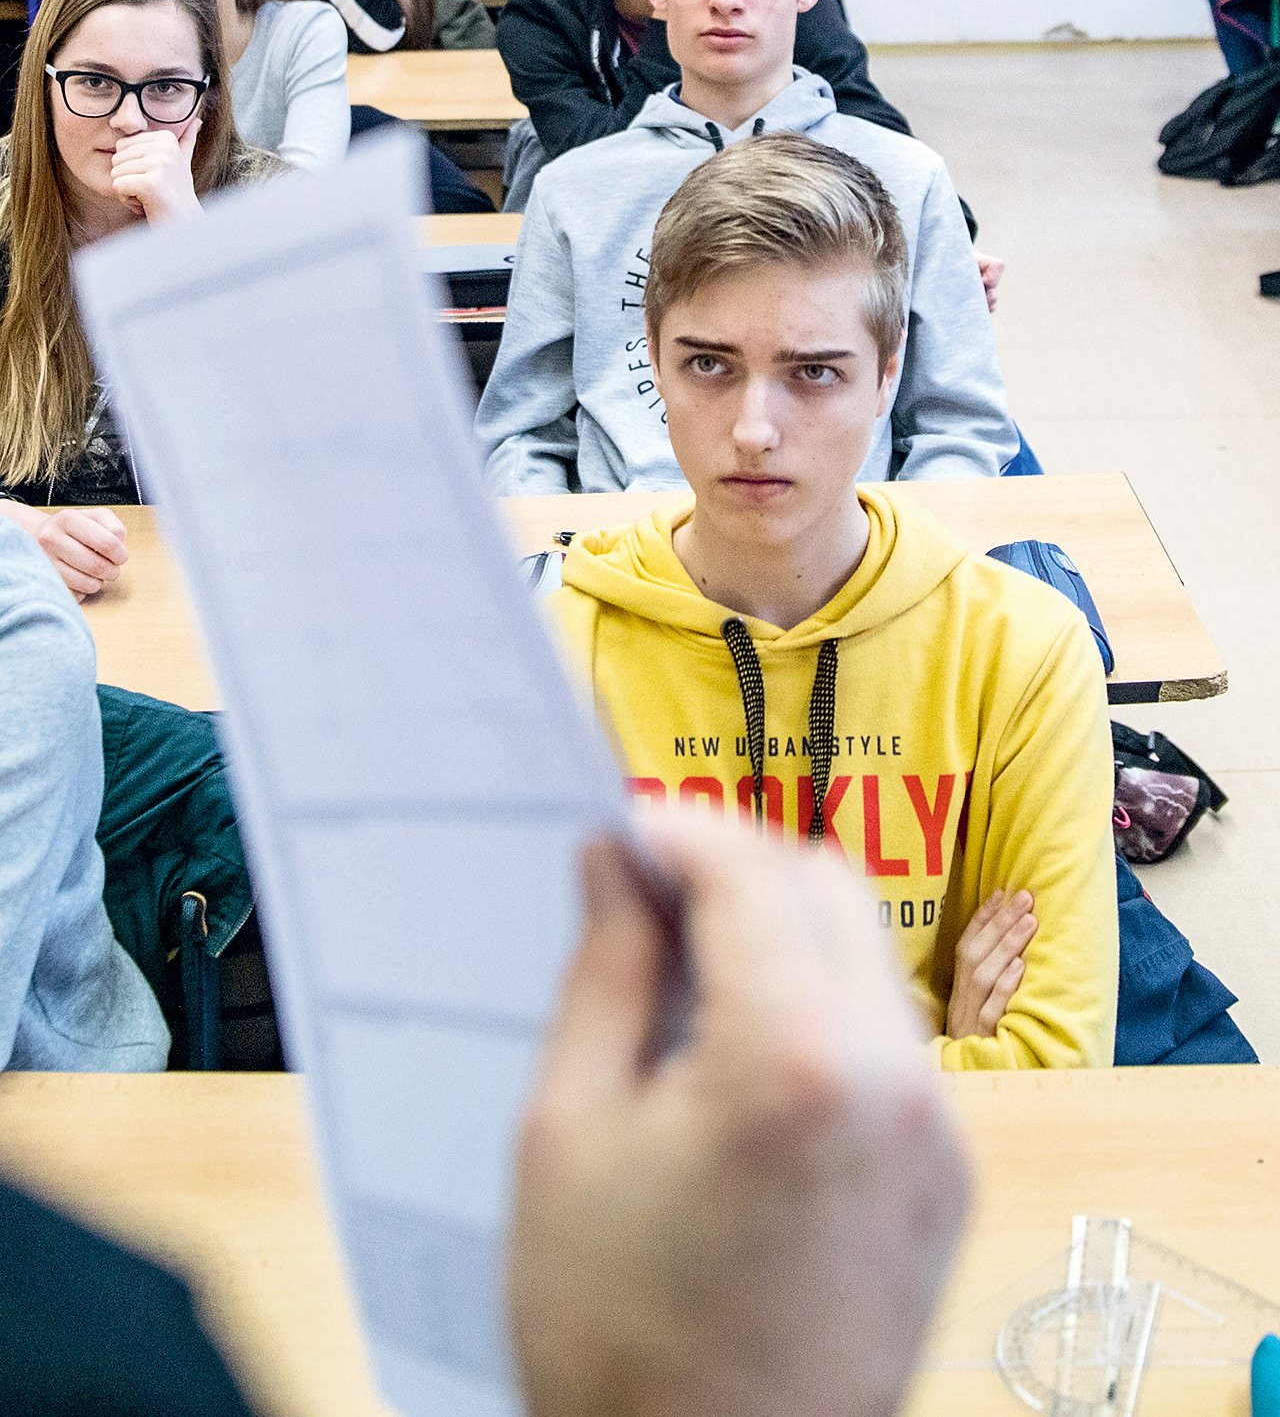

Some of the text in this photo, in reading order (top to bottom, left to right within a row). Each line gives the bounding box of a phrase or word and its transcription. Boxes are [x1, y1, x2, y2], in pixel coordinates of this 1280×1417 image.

[674, 735, 903, 757] NEW UBAN STYLE
[878, 895, 946, 929] OOD
